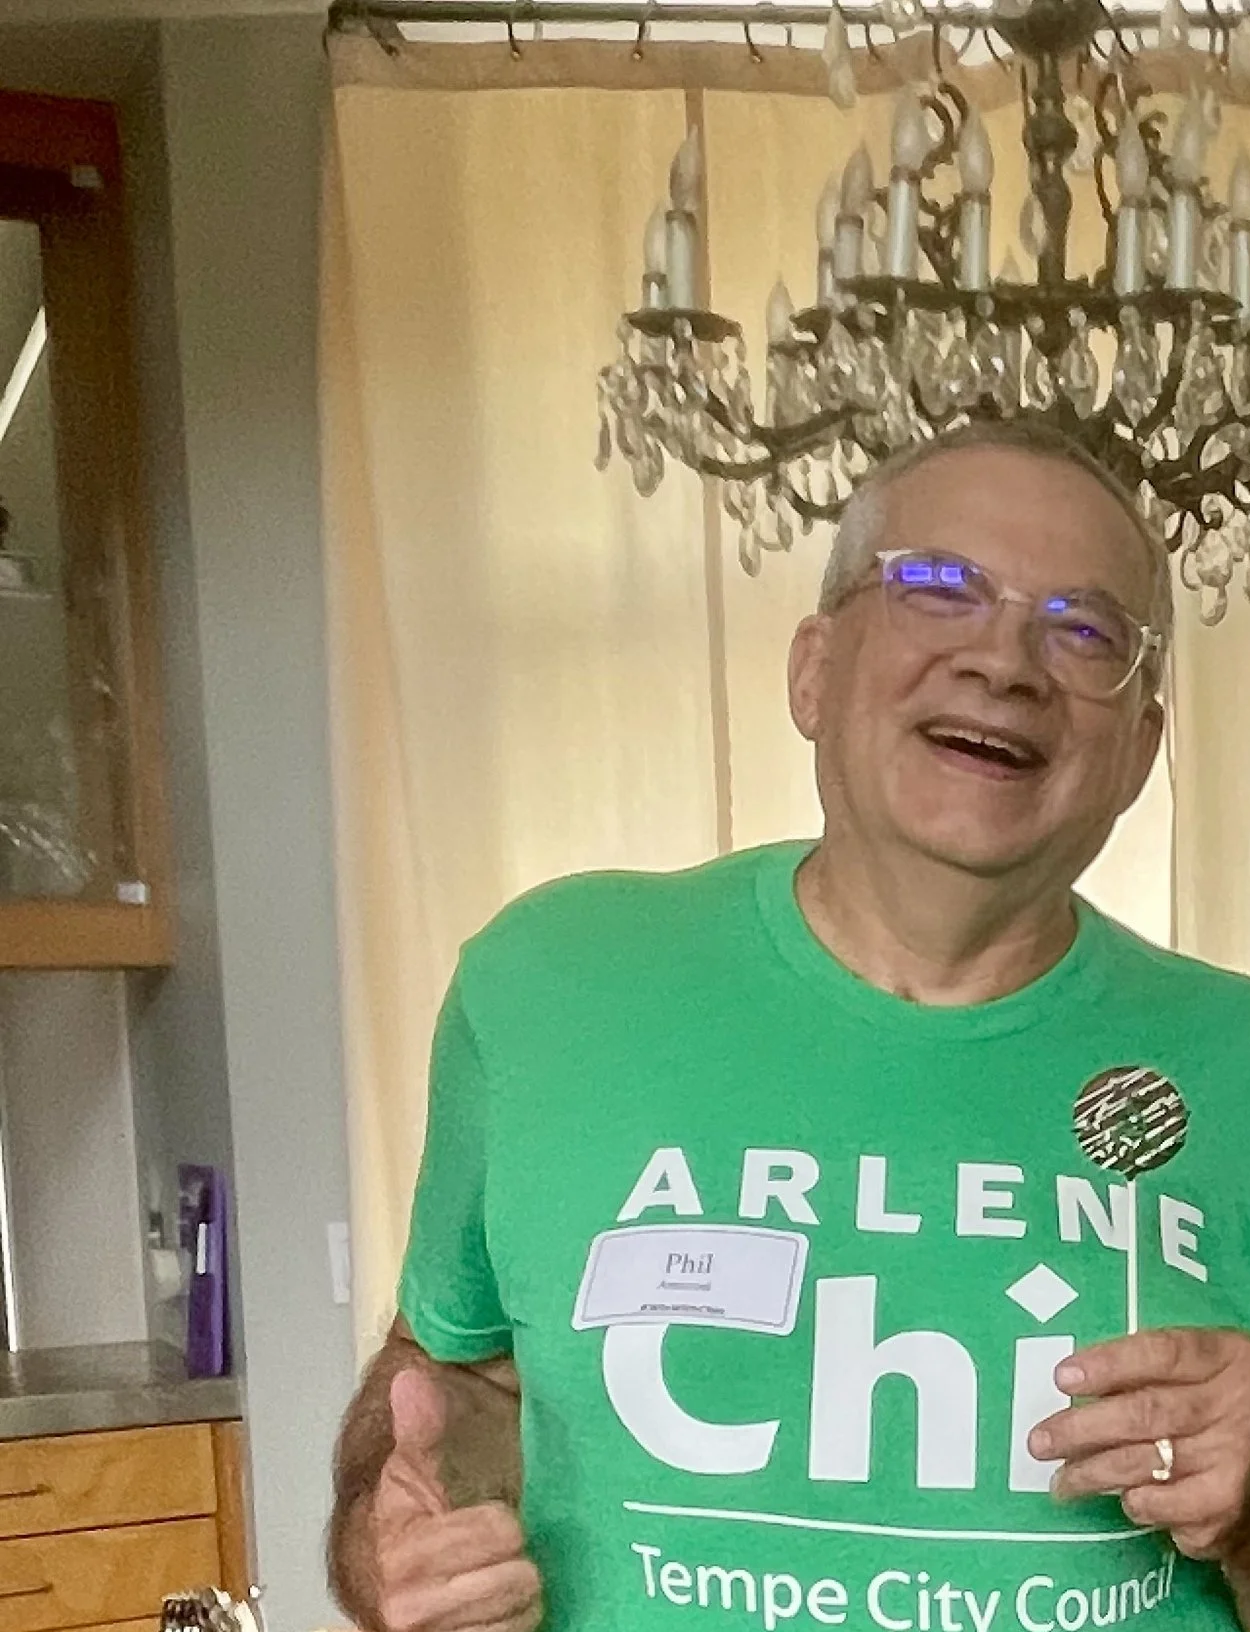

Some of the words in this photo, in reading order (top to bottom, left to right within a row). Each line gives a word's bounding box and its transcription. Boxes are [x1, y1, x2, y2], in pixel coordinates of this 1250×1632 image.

[616, 1147, 1208, 1282] ARLENE
[665, 1253, 714, 1275] Phil
[602, 1262, 1079, 1493] Chi
[630, 1543, 848, 1631] Tempe
